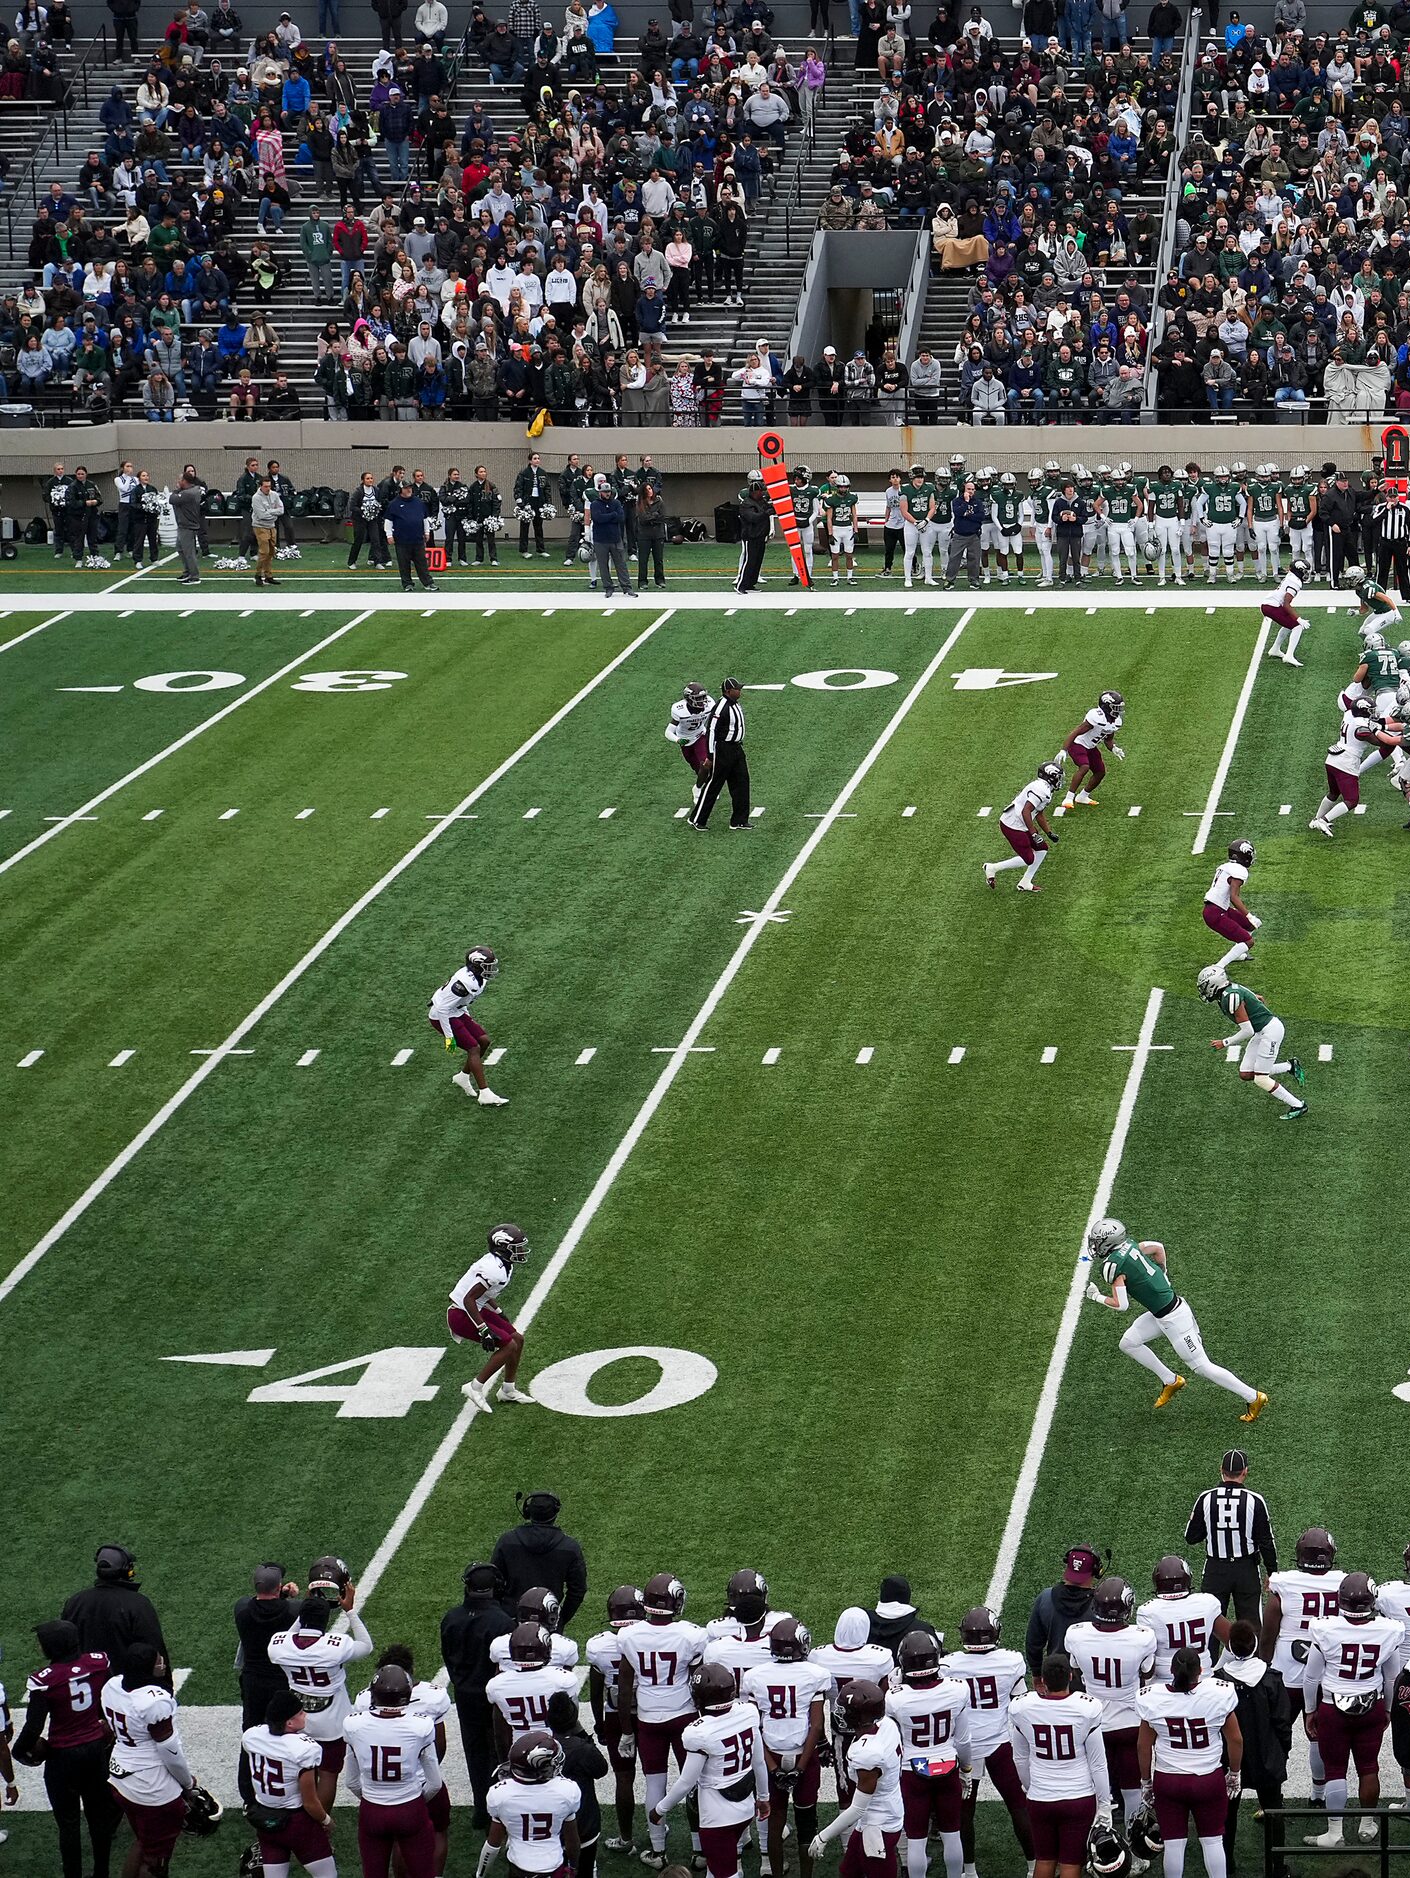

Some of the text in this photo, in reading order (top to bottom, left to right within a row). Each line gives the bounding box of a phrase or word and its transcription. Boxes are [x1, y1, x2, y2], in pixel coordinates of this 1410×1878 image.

[313, 233, 324, 245] R
[1392, 440, 1402, 462] 1
[834, 506, 852, 522] 22
[912, 496, 928, 512] 35
[1005, 503, 1014, 519] 9
[1111, 498, 1128, 514] 20
[1158, 493, 1175, 510] 32
[1215, 495, 1232, 511] 65
[1257, 496, 1273, 511] 10
[1290, 496, 1306, 512] 34
[1377, 654, 1399, 676] 72
[1129, 1248, 1156, 1277] 7
[1183, 1334, 1197, 1353] LIONS
[1215, 1498, 1241, 1529] H
[1165, 1617, 1207, 1654] 45
[636, 1651, 678, 1686] 47
[1091, 1656, 1123, 1688] 41
[1339, 1643, 1380, 1680] 93
[290, 1667, 331, 1687] 26
[69, 1673, 93, 1712] 5
[766, 1685, 797, 1719] 81
[846, 1694, 855, 1705] 7
[966, 1675, 999, 1710] 19
[504, 1695, 547, 1731] 34
[909, 1710, 951, 1748] 20
[1032, 1724, 1077, 1761] 90
[1165, 1717, 1210, 1750] 96
[369, 1744, 402, 1782] 16
[720, 1728, 754, 1777] 38
[249, 1752, 286, 1797] 42
[521, 1812, 554, 1841] 13
